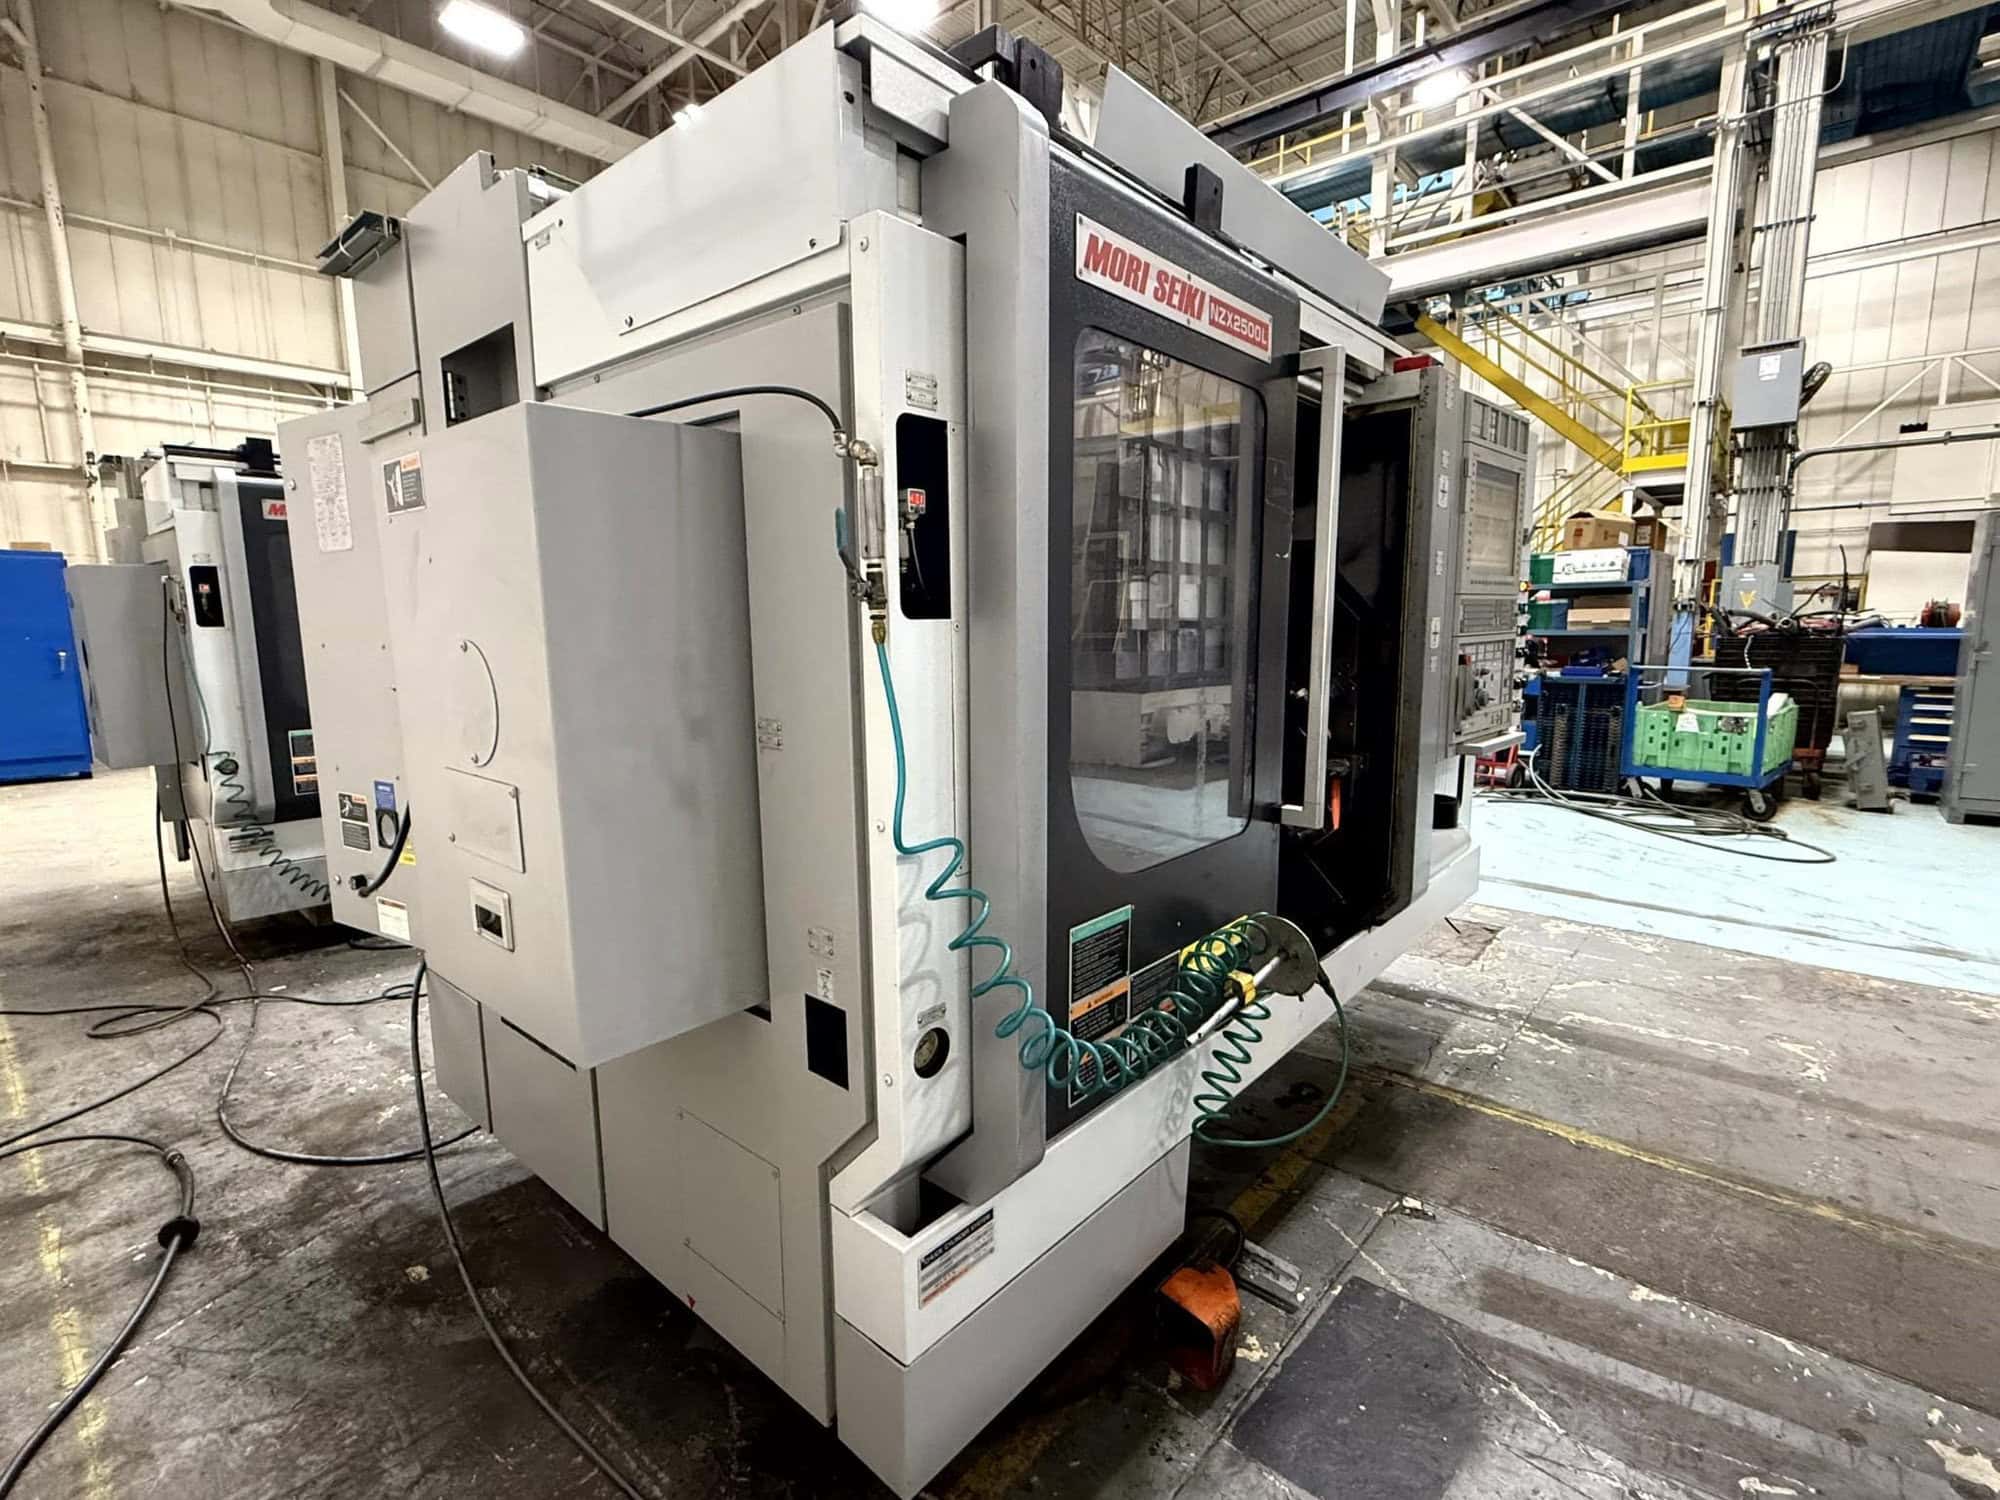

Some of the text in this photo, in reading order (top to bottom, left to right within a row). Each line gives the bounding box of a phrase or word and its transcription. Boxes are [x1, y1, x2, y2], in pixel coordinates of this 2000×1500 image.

[1083, 232, 1267, 345] MORI SEIKI NZX2500L
